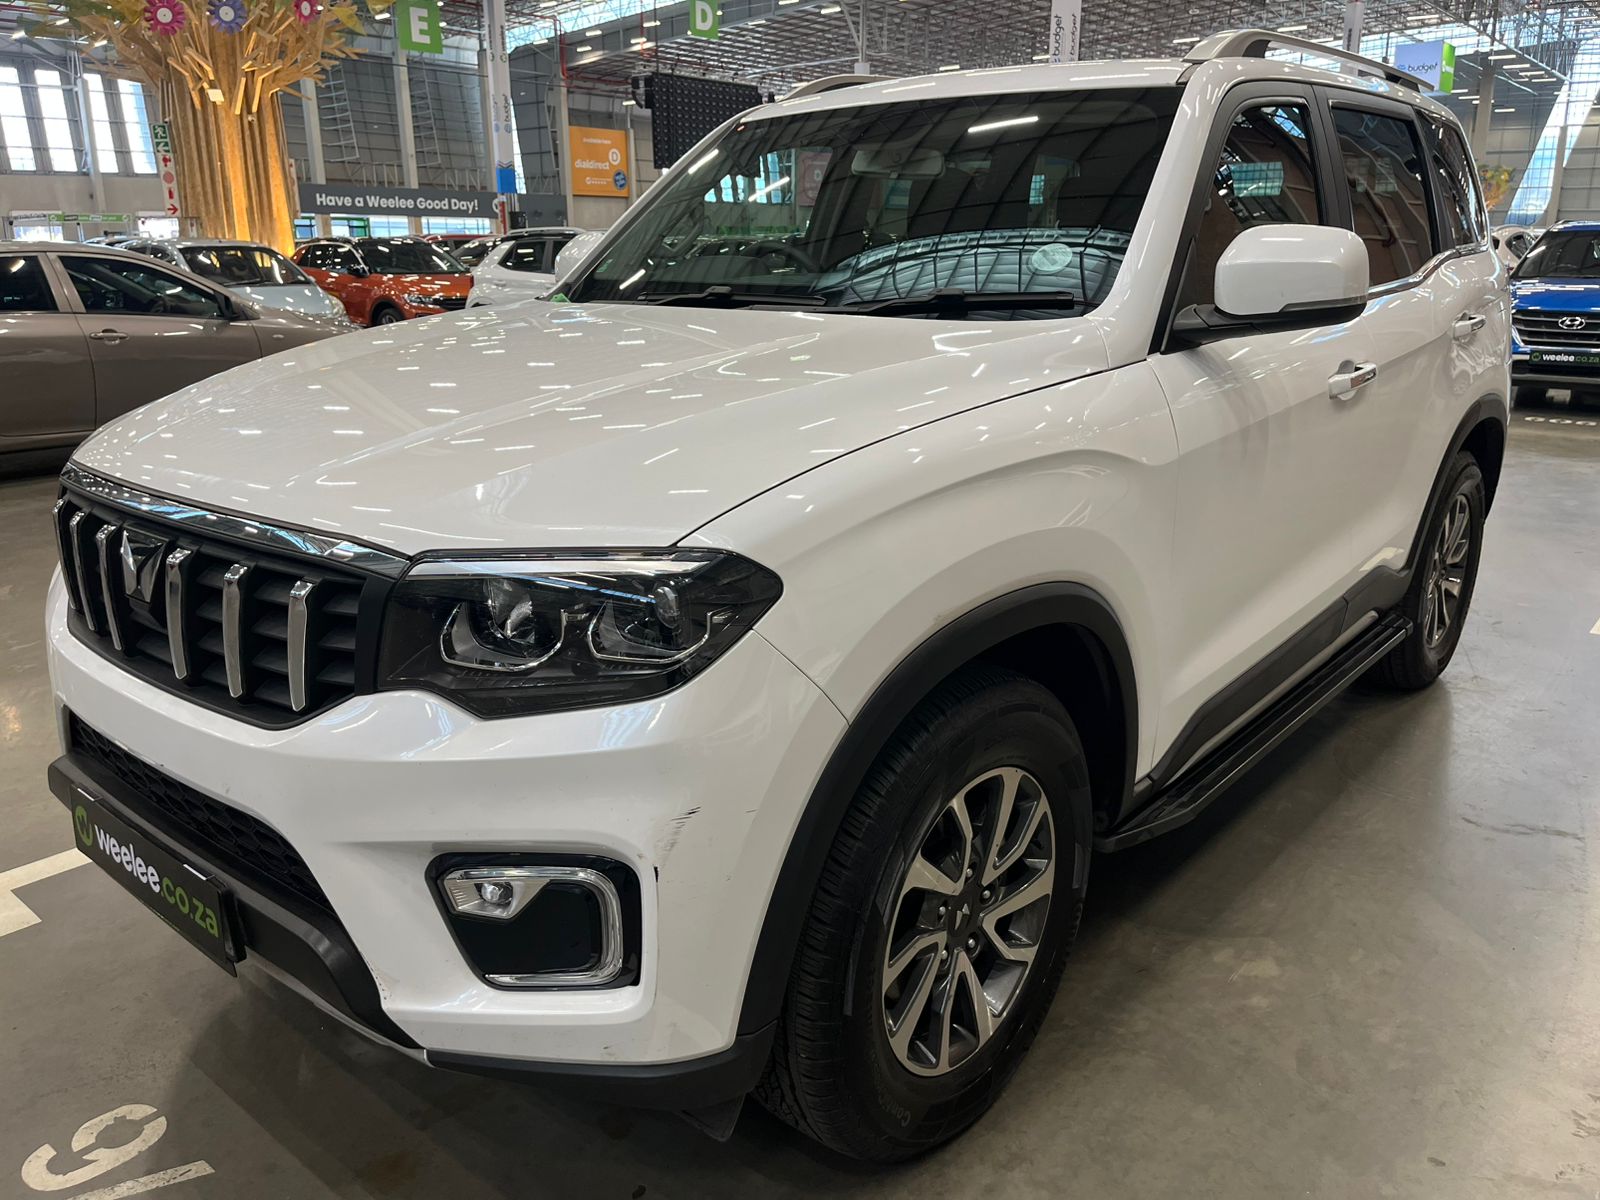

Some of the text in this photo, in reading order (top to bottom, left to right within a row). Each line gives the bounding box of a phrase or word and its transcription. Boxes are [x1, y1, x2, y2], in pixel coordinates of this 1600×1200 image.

[409, 6, 431, 44] E
[695, 0, 714, 31] D
[1052, 14, 1065, 56] budget
[1407, 62, 1438, 74] budget
[575, 159, 610, 170] dialdirect
[316, 193, 479, 214] Have a Weelee Good Day!
[94, 823, 219, 938] weelee.co.za
